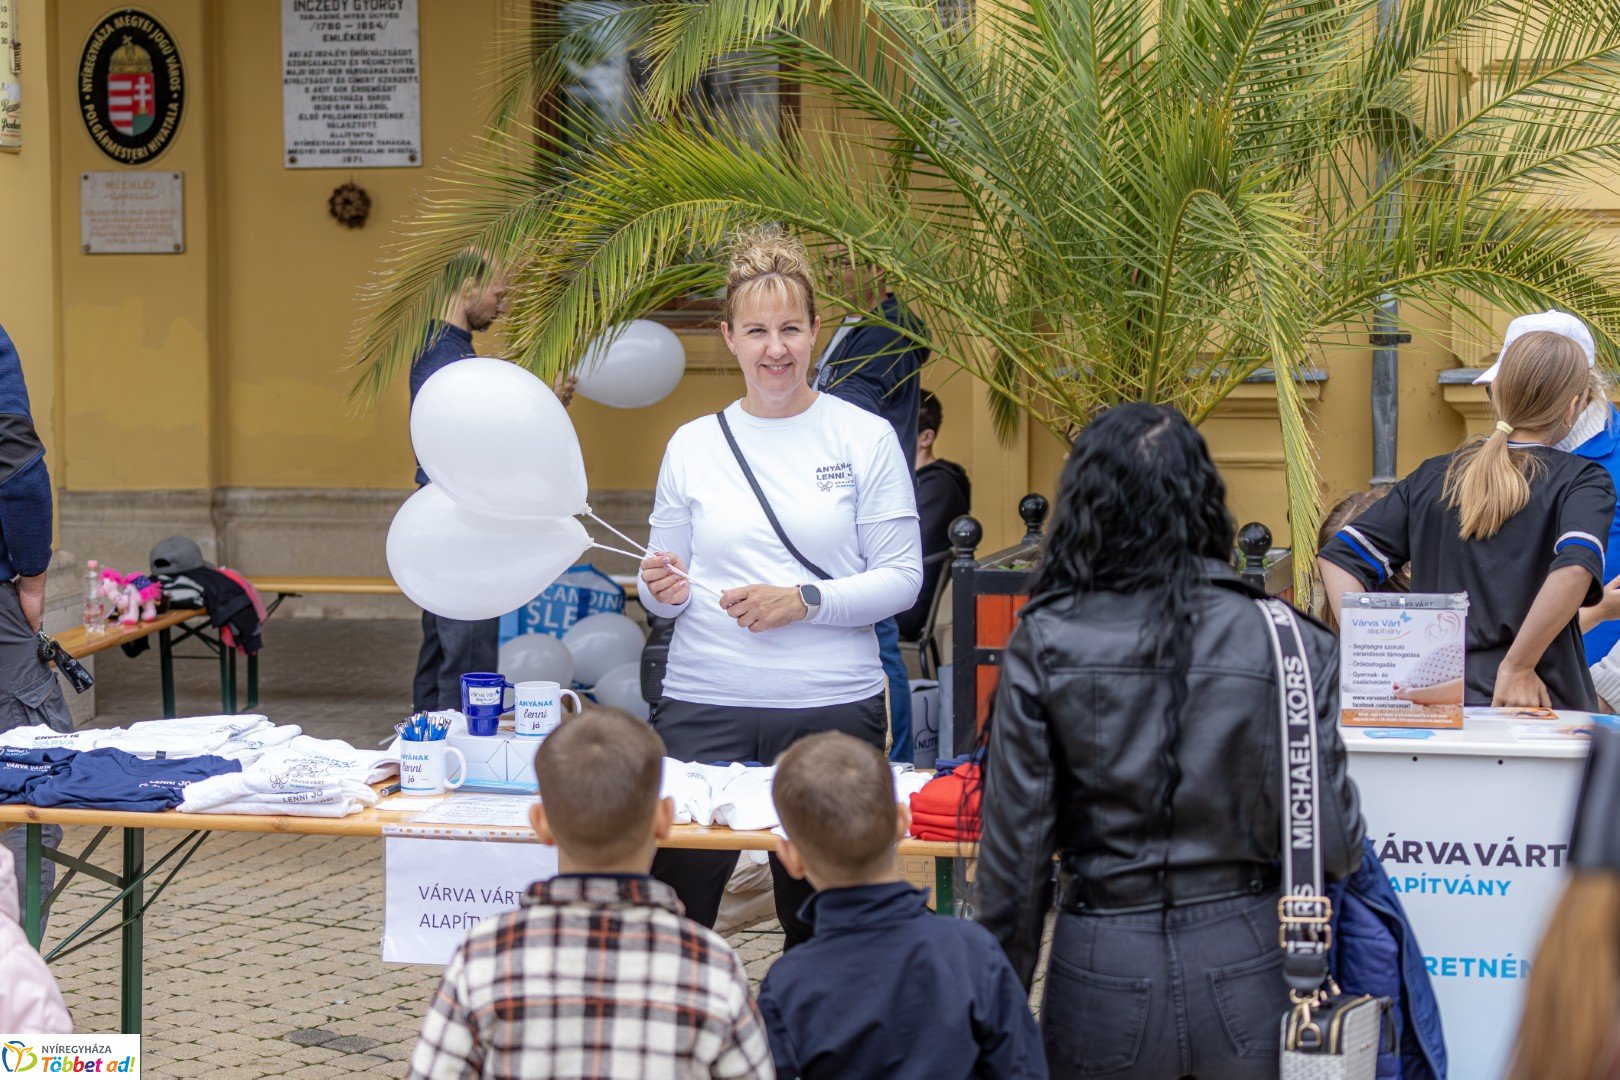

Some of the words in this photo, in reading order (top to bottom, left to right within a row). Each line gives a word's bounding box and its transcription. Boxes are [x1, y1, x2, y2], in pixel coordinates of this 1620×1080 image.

[113, 14, 155, 33] MEGYEI
[322, 32, 377, 43] EMLÉKÉRE
[83, 103, 149, 160] POLGÁRMESTERI
[146, 102, 180, 153] HIVATALA
[816, 472, 845, 481] LENNI
[1352, 618, 1379, 628] Várva
[1382, 618, 1401, 628] Várt
[1284, 654, 1310, 727] KORS
[519, 699, 553, 707] ANYÁNAK
[523, 708, 548, 719] lenni
[532, 721, 541, 731] jó
[402, 761, 423, 773] lenni
[407, 775, 415, 784] jó
[1289, 732, 1314, 850] MICHAEL
[282, 793, 309, 803] LENNI
[418, 883, 476, 903] VÁRVA
[480, 886, 524, 905] VÁRT
